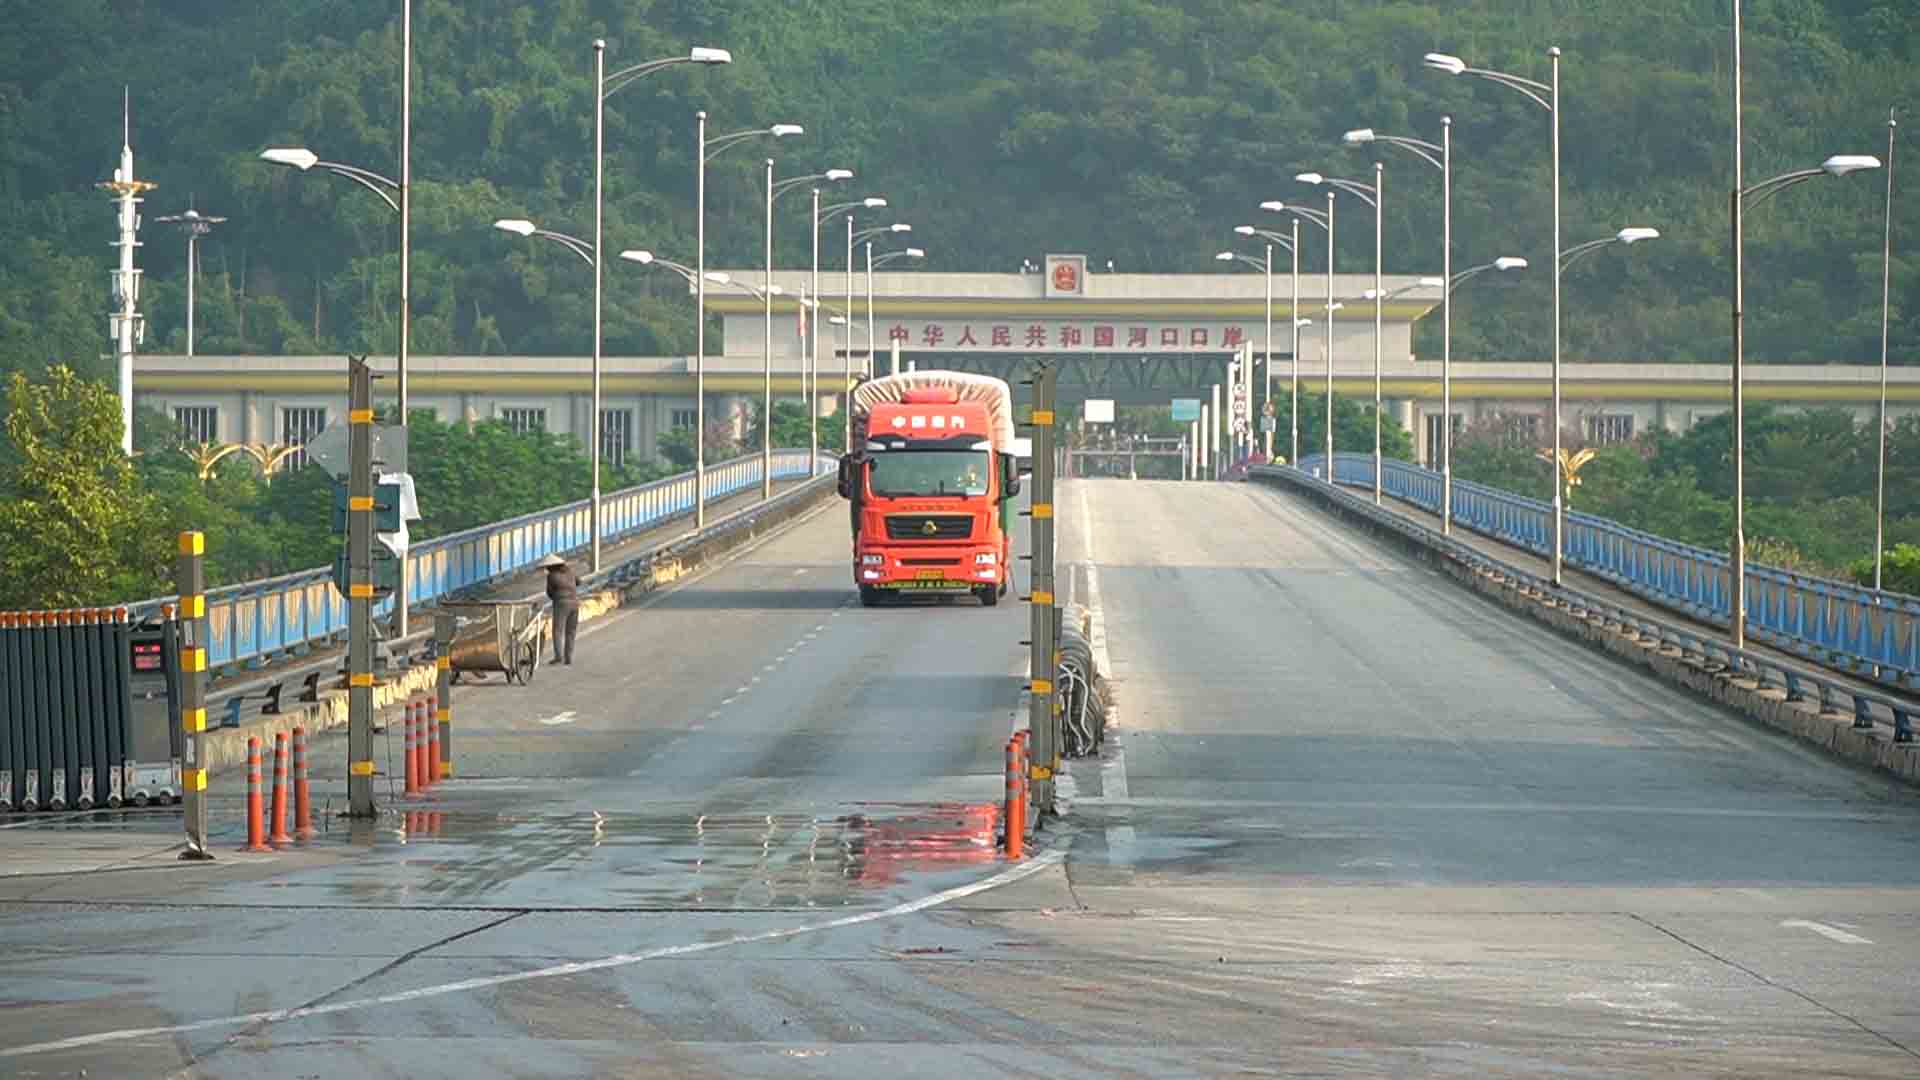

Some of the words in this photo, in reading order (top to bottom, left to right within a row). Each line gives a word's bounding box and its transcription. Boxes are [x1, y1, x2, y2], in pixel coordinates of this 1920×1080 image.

[889, 324, 1244, 348] 中华人民共和国河口口岸
